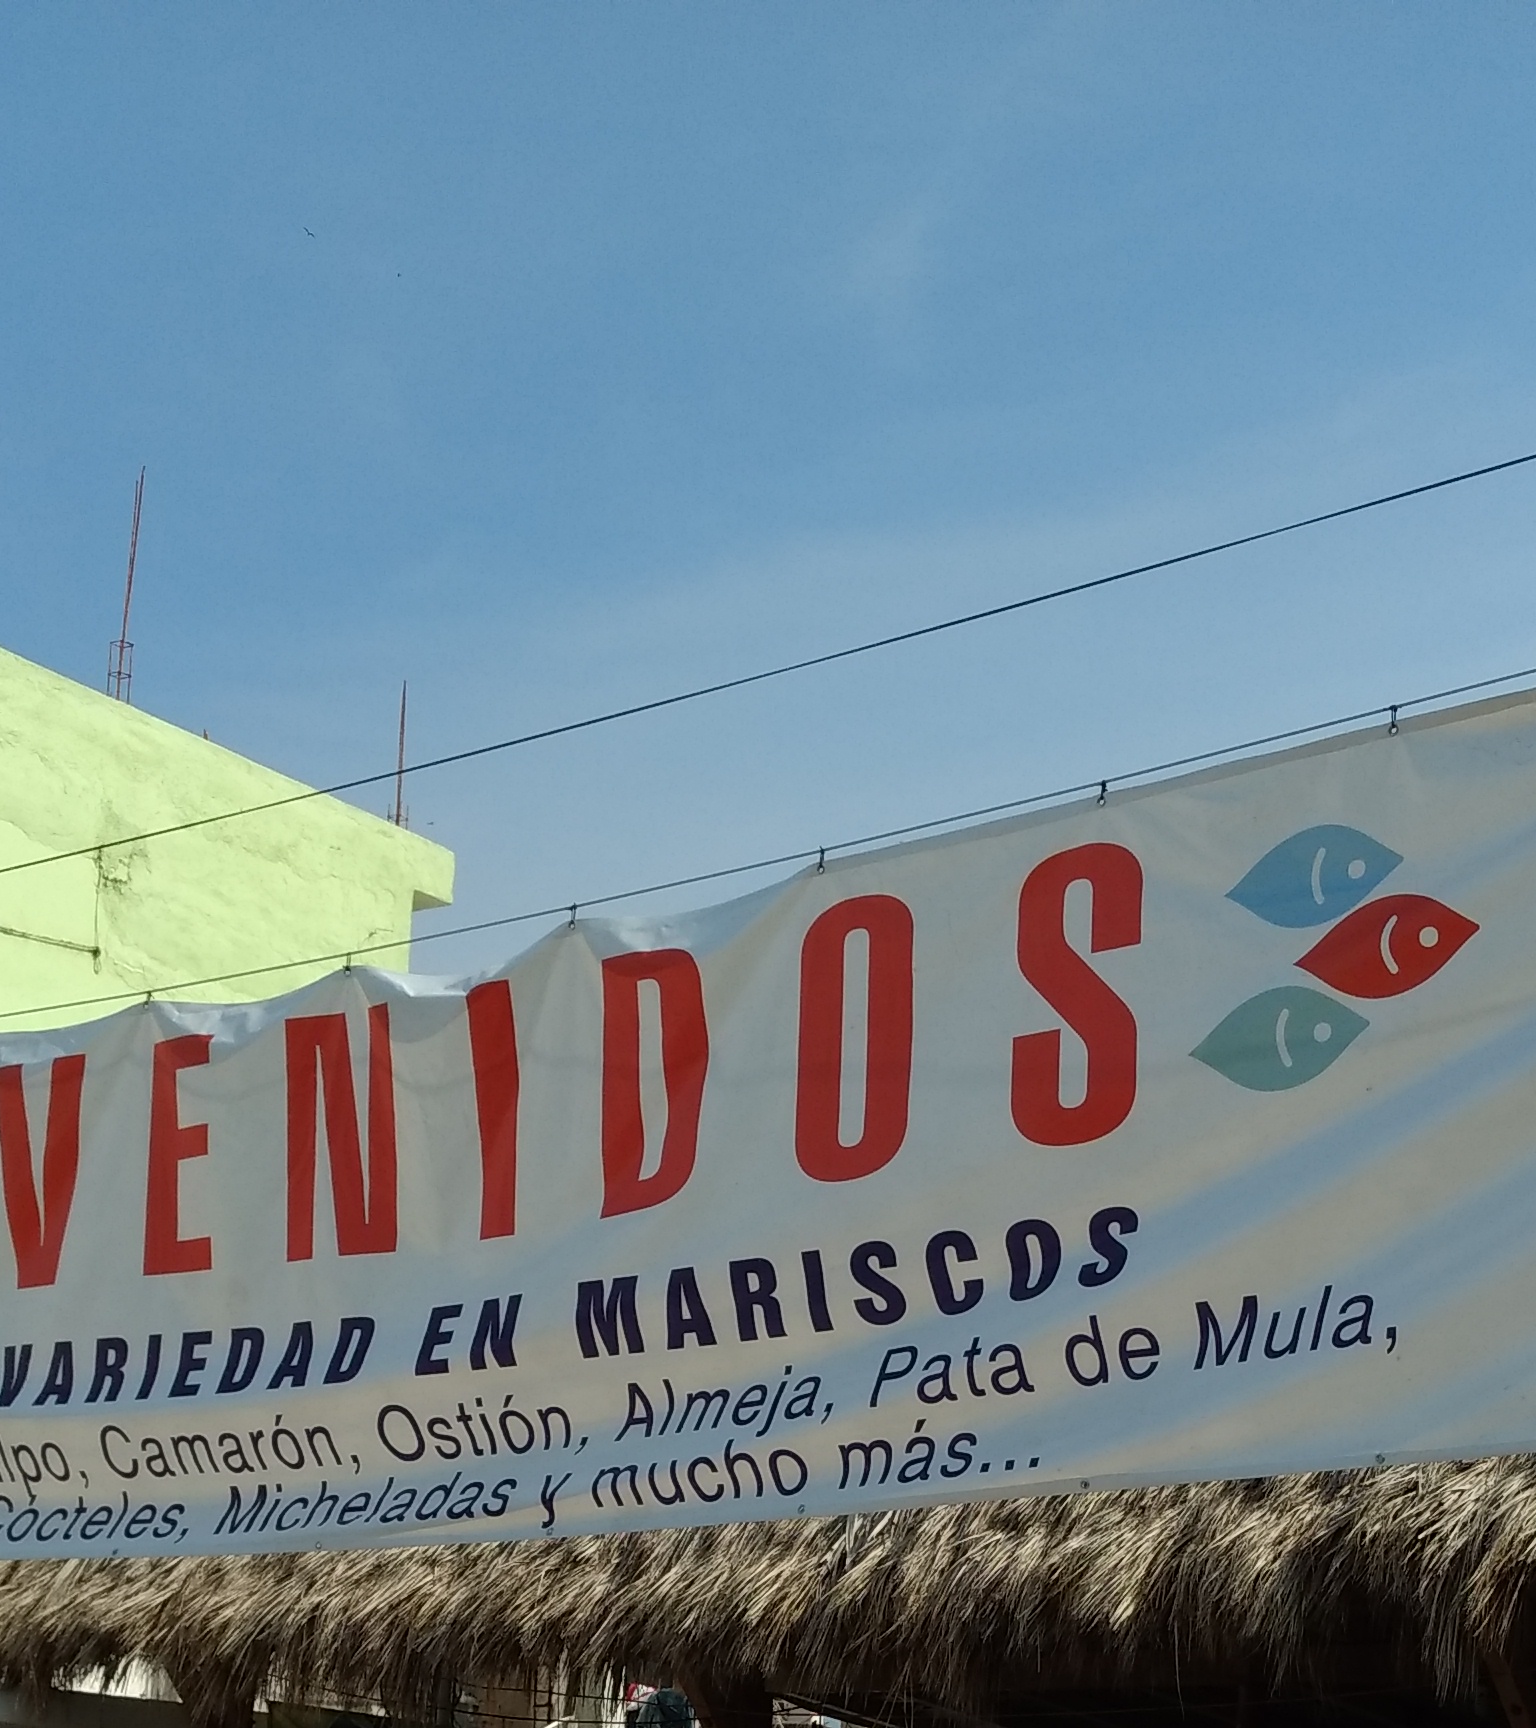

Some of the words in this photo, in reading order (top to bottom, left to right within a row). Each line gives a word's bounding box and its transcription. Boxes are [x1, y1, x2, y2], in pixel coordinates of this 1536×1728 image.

[415, 1293, 522, 1377] EN
[575, 1206, 1140, 1359] MARISCOS
[101, 1414, 362, 1479] Camarón,
[375, 1394, 590, 1465] Ostión,
[612, 1363, 835, 1446] Almeja,
[868, 1336, 1034, 1409] Pata
[1064, 1314, 1160, 1387] de
[1191, 1285, 1399, 1372] Mula,
[213, 1471, 517, 1537] Micheladas
[537, 1469, 574, 1530] y
[591, 1438, 809, 1509] mucho
[837, 1418, 1042, 1489] más...
